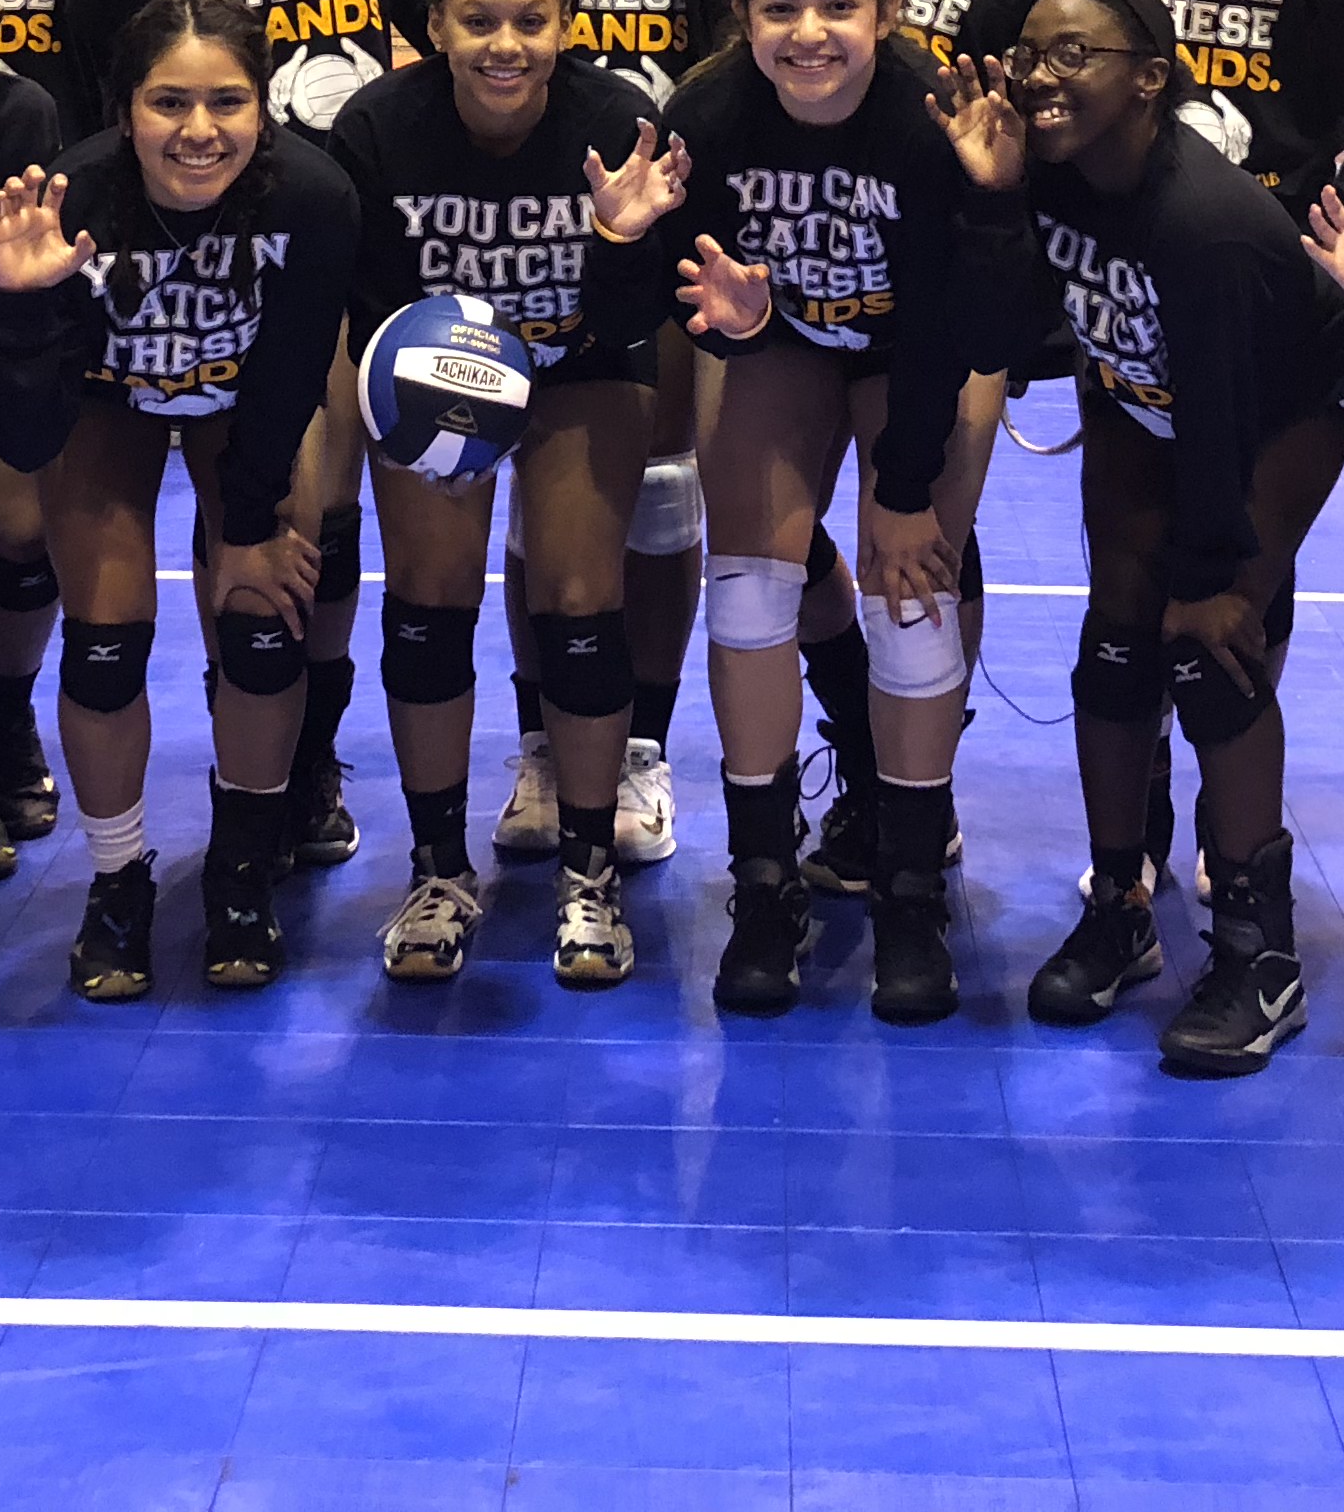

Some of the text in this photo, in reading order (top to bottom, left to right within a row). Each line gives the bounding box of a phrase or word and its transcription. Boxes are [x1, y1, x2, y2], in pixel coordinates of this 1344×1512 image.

[565, 12, 689, 53] ANDS
[1176, 43, 1281, 92] NDS.
[726, 166, 902, 220] YOU CAN
[393, 193, 499, 243] YOU
[737, 212, 886, 261] CATCH
[420, 239, 587, 289] CATCH
[450, 323, 502, 345] OFFICIAL
[434, 356, 502, 387] TACHIKARA
